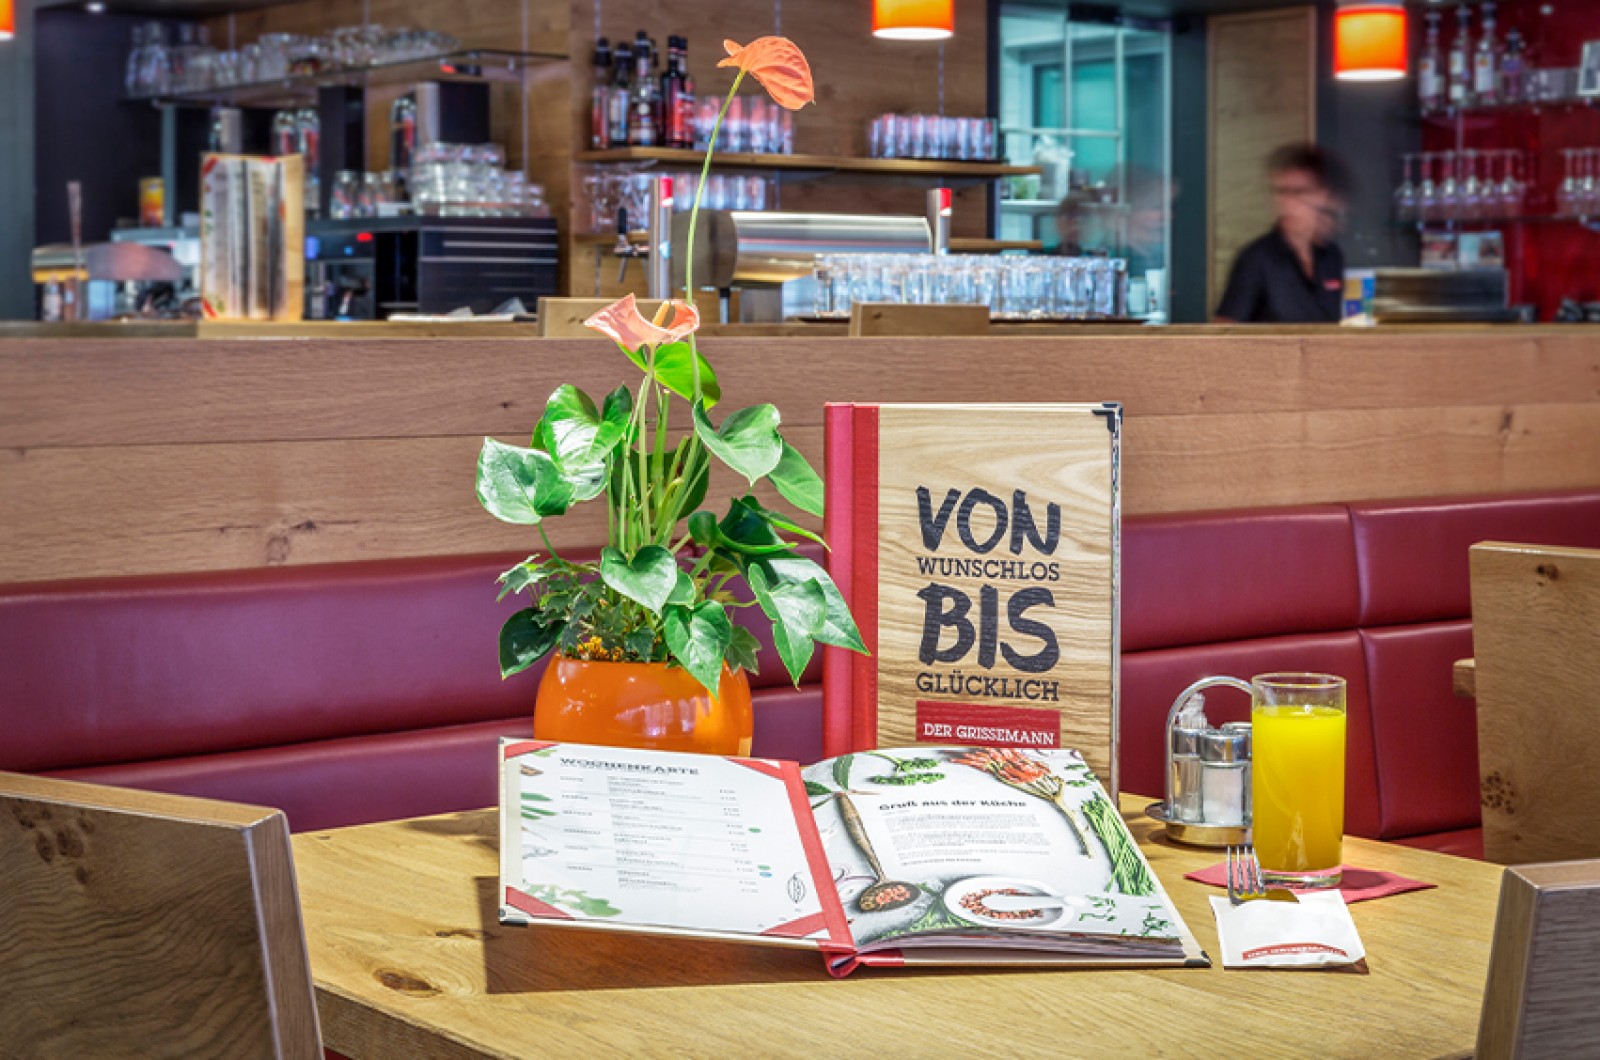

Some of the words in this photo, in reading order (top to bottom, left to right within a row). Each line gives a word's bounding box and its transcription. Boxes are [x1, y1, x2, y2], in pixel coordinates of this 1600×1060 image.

[915, 485, 1061, 556] VON
[916, 557, 1060, 581] WUNSCHLOS
[916, 582, 1060, 673] BIS
[916, 669, 1060, 701] GLÜCKLICH
[923, 723, 952, 737] DER
[956, 725, 1054, 745] GRISSEMANN
